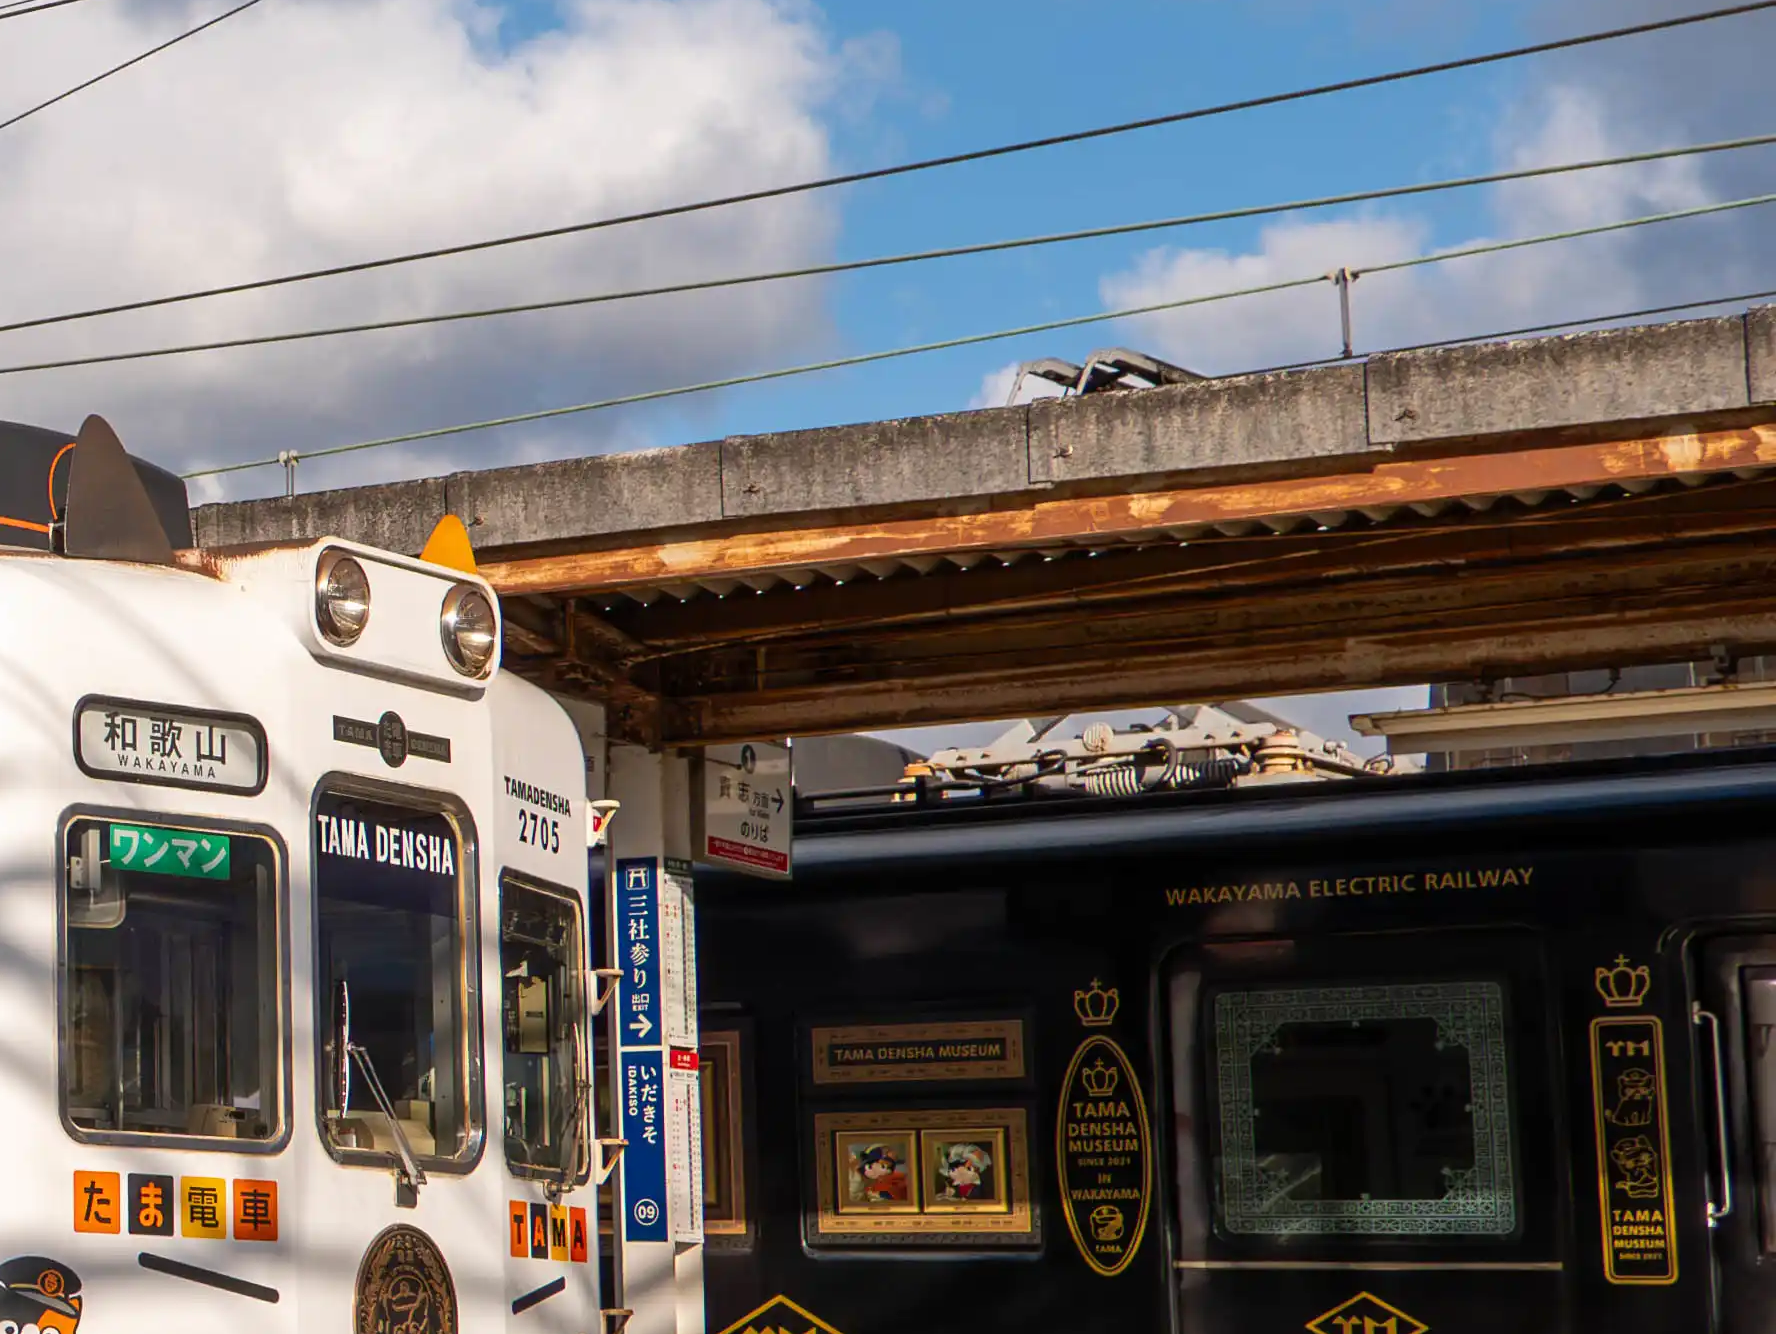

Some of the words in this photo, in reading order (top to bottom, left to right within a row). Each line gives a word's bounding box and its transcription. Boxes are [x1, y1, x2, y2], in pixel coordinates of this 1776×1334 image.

[104, 710, 227, 766] 和歌山
[117, 753, 217, 779] WAKAYAMA
[504, 775, 572, 817] TAMADENSHA
[518, 809, 561, 855] 2705
[740, 821, 770, 843] のりば
[112, 828, 227, 874] ワンマン
[318, 815, 369, 860] TAMA
[376, 827, 454, 876] DENSHA
[1166, 880, 1301, 906] WAKAYAMA
[1309, 873, 1416, 898] ELECTRIC
[1424, 867, 1535, 893] RAILWAY
[628, 894, 650, 989] 三社参り
[631, 993, 650, 1004] 出口
[631, 1004, 649, 1012] EXIT
[835, 1049, 874, 1062] TAMA
[878, 1046, 935, 1060] DENSHA
[939, 1043, 1001, 1058] MUSEUM
[628, 1065, 639, 1117] IDAKISO
[640, 1064, 658, 1145] いだきそ
[1073, 1101, 1131, 1119] TAMA
[1068, 1122, 1138, 1137] DENSHA
[1068, 1138, 1140, 1153] MUSEUM
[1070, 1189, 1141, 1201] WAKAYAMA
[83, 1182, 272, 1232] たま電車
[637, 1205, 655, 1219] 09
[1612, 1210, 1665, 1222] TAMA
[513, 1212, 586, 1252] TAMA
[1613, 1225, 1665, 1236] DENSHA
[1095, 1244, 1123, 1254] TAMA
[1614, 1238, 1666, 1249] MUSEUM
